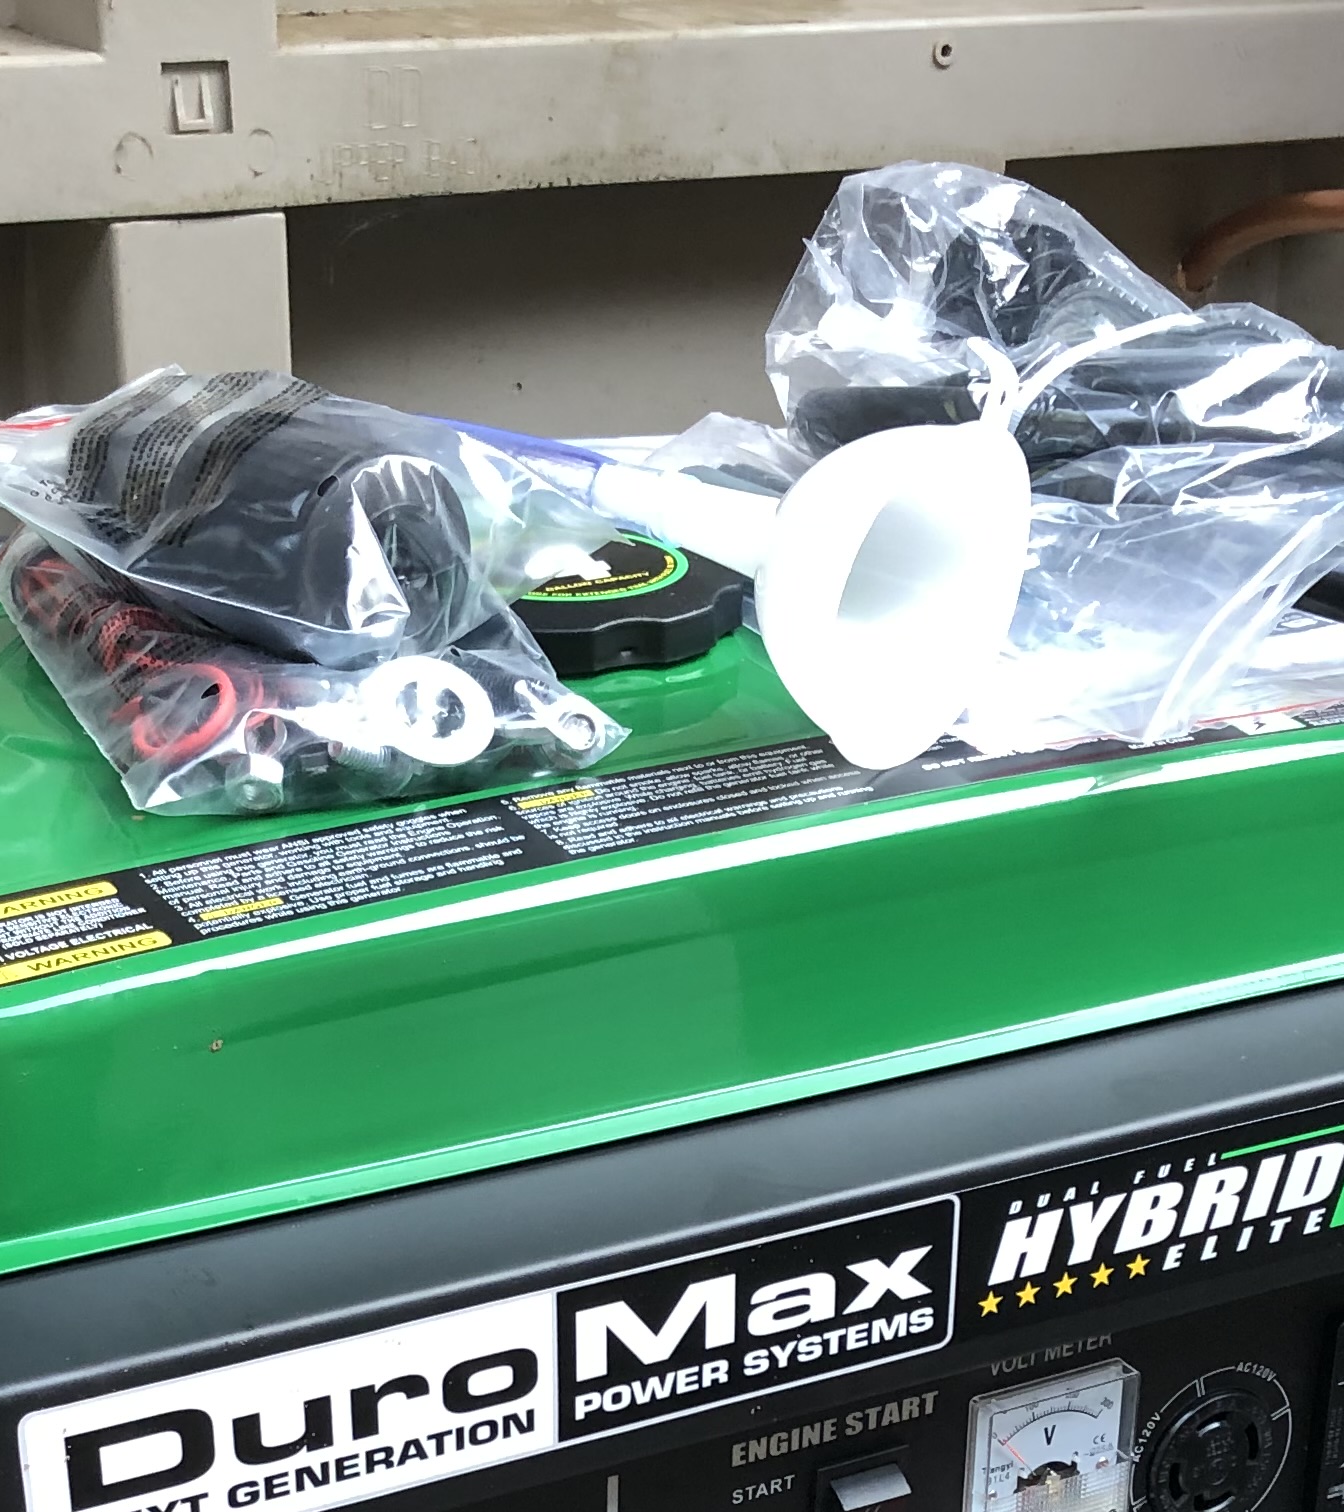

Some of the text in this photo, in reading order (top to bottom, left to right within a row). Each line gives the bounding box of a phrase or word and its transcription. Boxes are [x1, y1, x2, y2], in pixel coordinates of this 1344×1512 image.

[4, 941, 68, 959] VOLTAGE
[69, 923, 154, 945] ELECTRICAL
[27, 937, 157, 971] WARNING
[1009, 1153, 1223, 1214] DUAL FUEL
[1163, 1213, 1326, 1270] ELITE
[574, 1307, 933, 1421] POWER SYSTEMS
[1236, 1361, 1276, 1382] AC120V
[732, 1390, 938, 1466] ENGINE START
[1043, 1424, 1056, 1445] V
[227, 1408, 534, 1507] GENERATION
[732, 1474, 794, 1503] START
